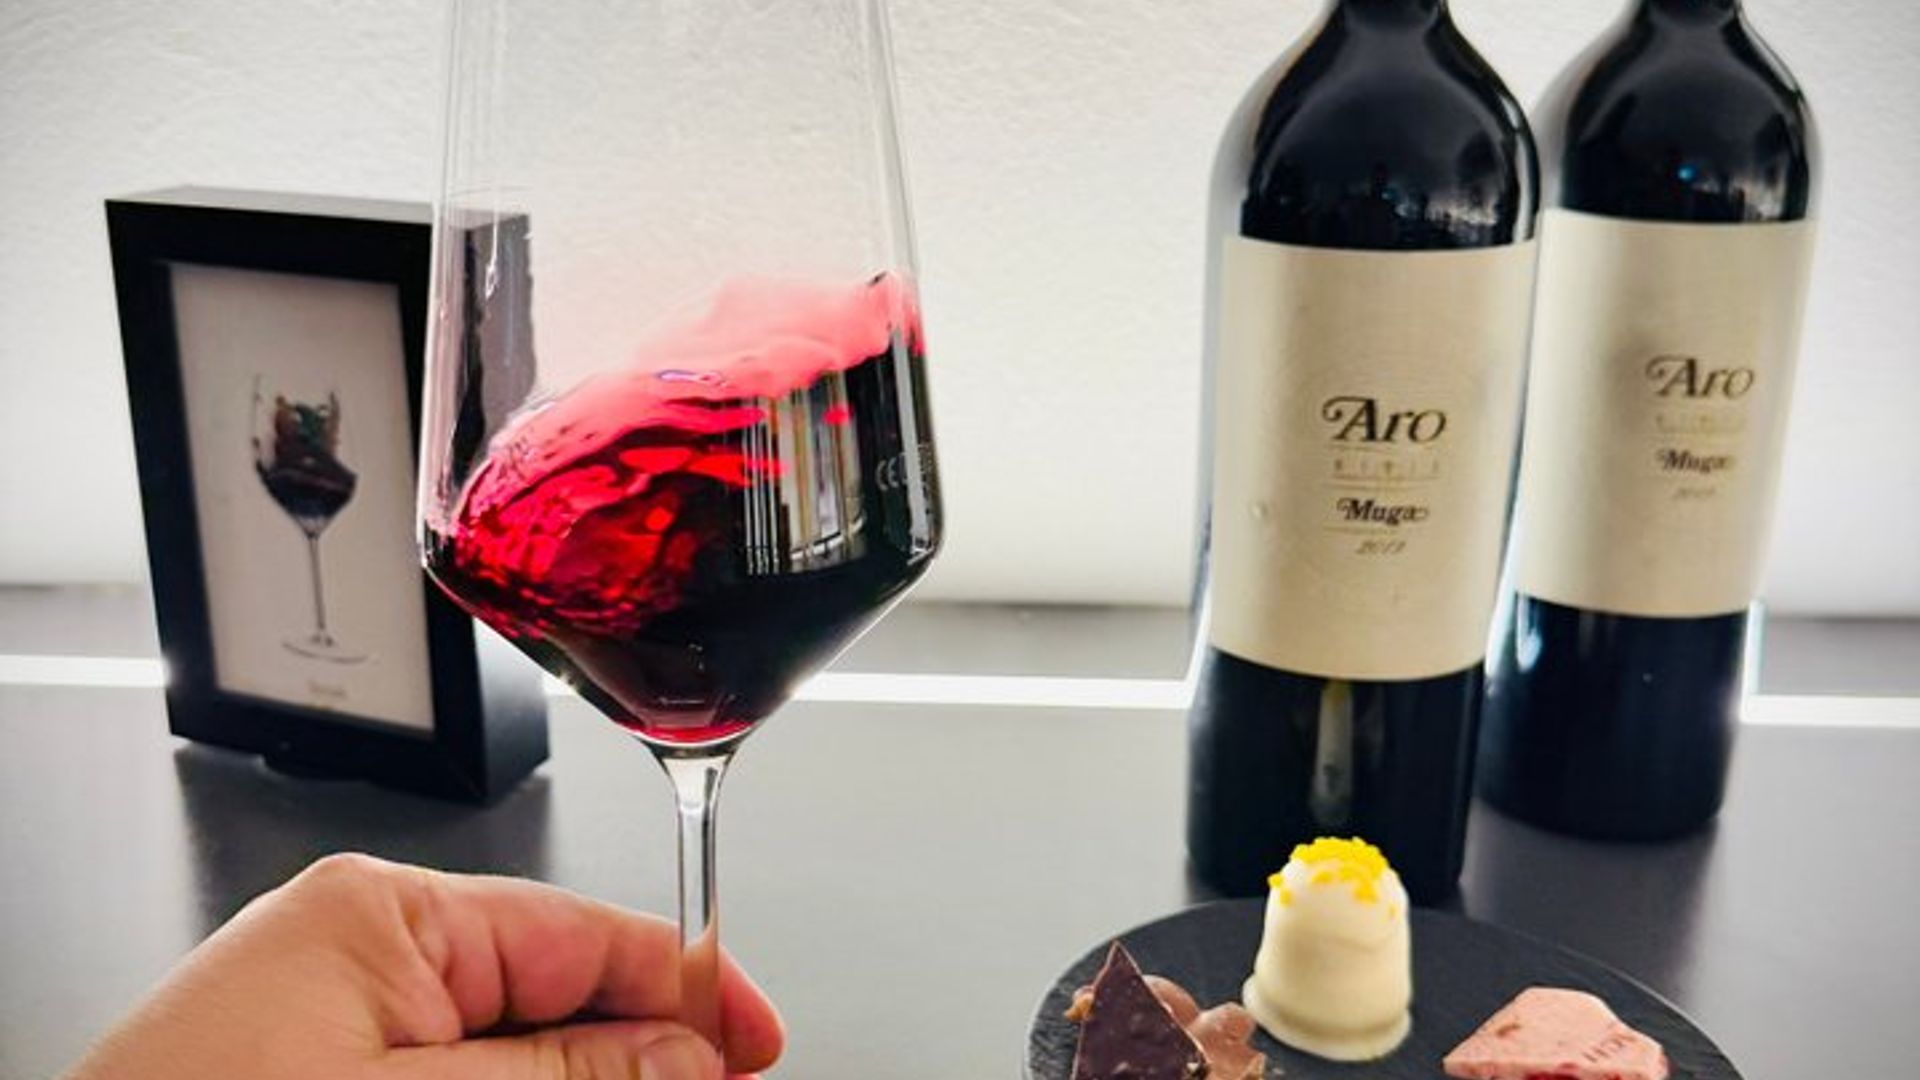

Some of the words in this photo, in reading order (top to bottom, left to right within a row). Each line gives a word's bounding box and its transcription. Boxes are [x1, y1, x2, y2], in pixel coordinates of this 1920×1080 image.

[1645, 354, 1755, 401] Aro
[1322, 396, 1447, 443] Aro
[1656, 450, 1737, 475] Muga
[1336, 497, 1430, 527] Muga
